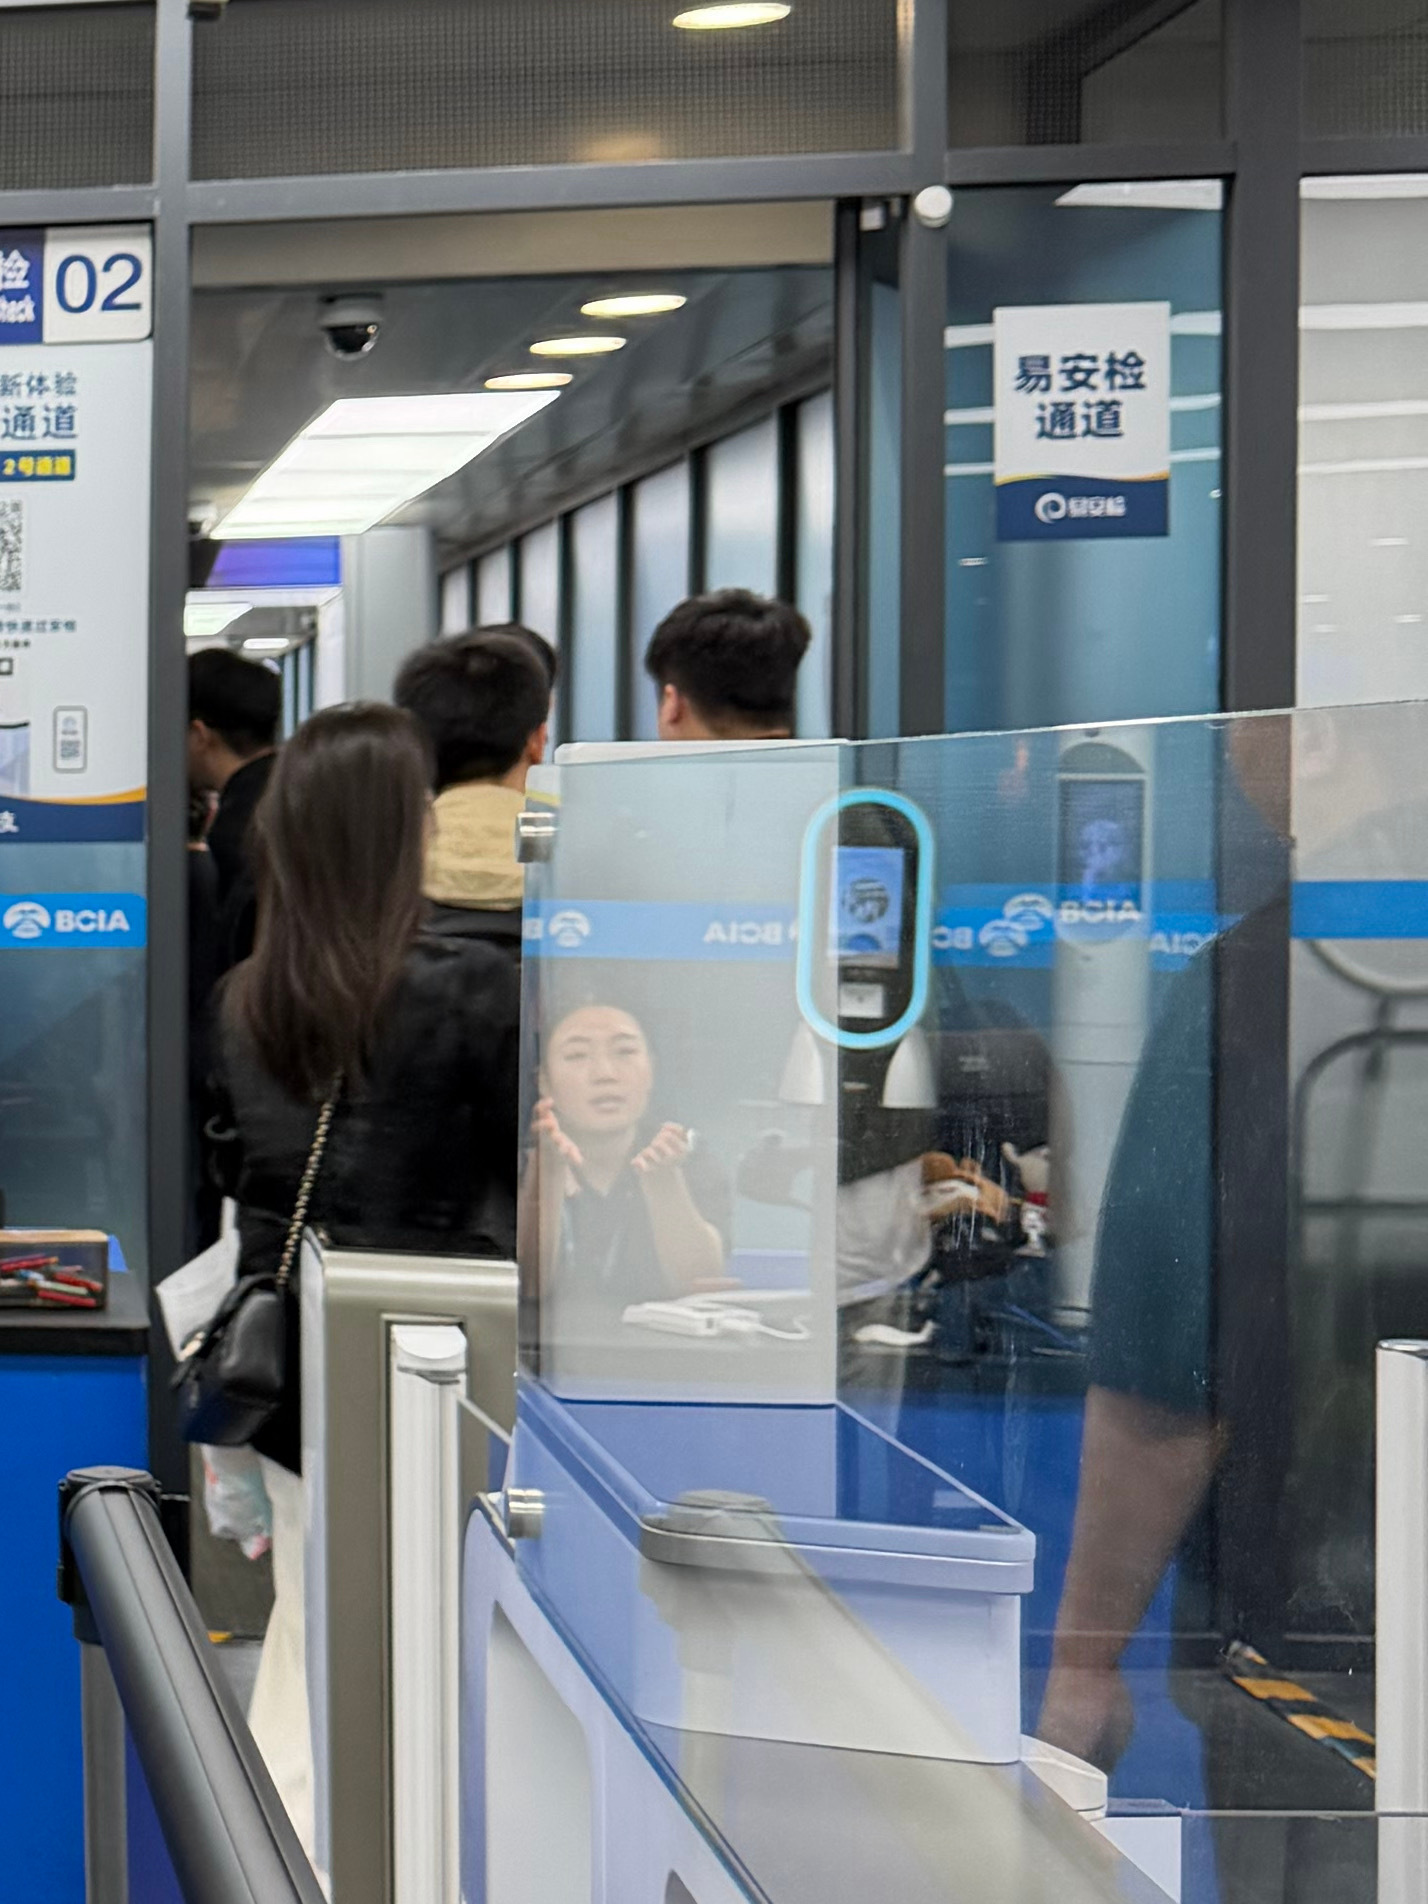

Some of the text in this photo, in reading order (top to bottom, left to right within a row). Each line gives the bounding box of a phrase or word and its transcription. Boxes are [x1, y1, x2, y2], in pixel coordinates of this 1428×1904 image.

[55, 253, 143, 314] 02
[1014, 350, 1147, 394] 易安检
[1034, 400, 1124, 440] 通道
[55, 909, 130, 933] BCIA
[1057, 900, 1142, 924] BCIA
